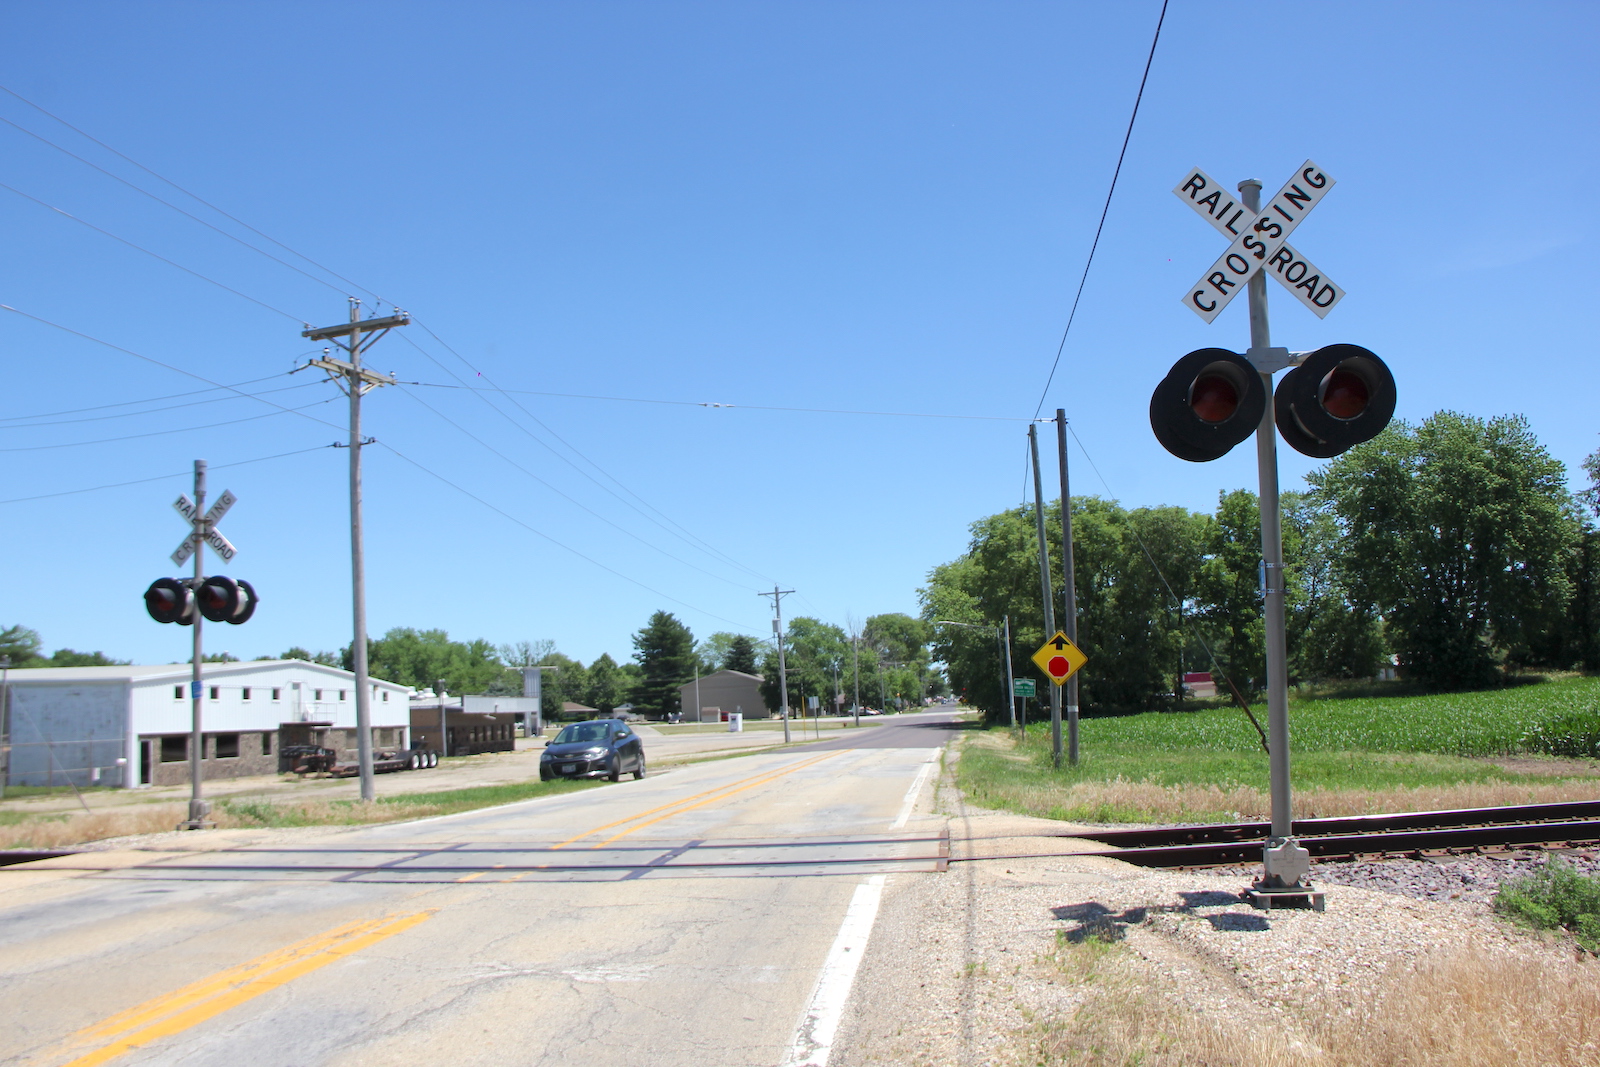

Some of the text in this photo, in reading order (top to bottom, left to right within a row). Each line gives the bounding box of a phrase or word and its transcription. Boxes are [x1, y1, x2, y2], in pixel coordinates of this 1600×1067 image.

[1181, 172, 1336, 308] RAIL ROAD
[1192, 167, 1327, 312] CROSSING
[209, 531, 234, 560] ROAD
